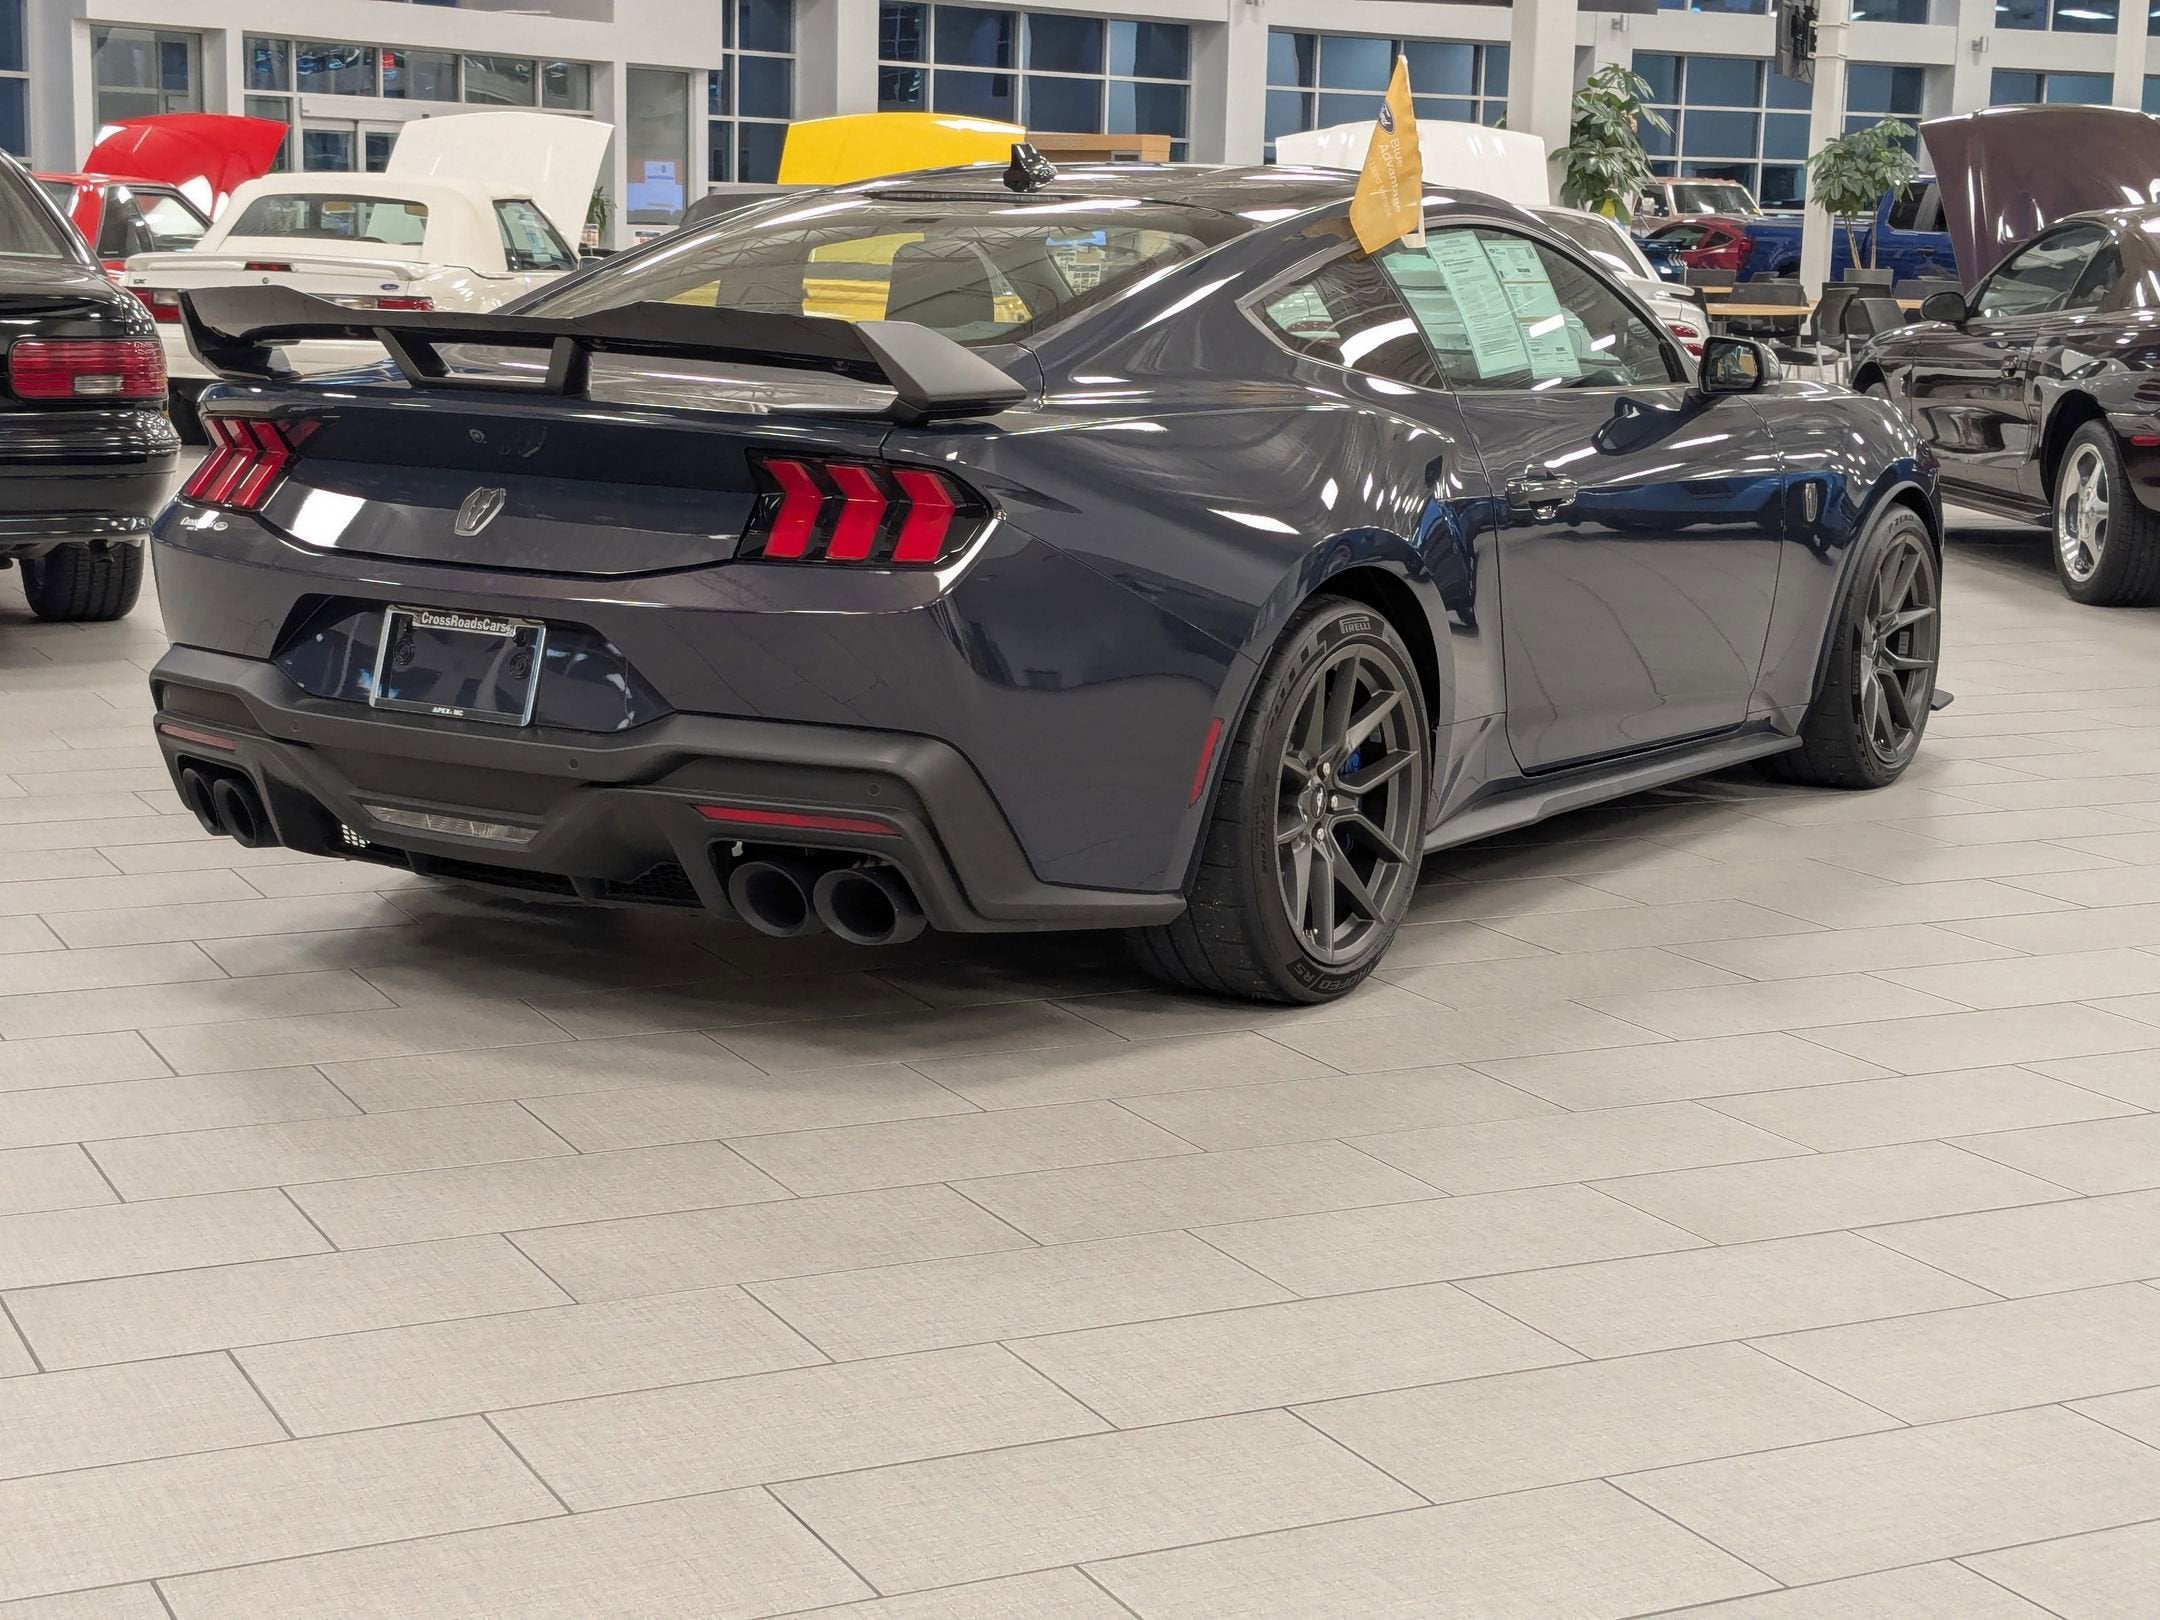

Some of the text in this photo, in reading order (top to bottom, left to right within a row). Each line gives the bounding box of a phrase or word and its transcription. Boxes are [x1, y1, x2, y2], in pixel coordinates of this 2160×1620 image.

[1391, 138, 1404, 168] Blue
[1378, 143, 1402, 213] Advantage
[1338, 616, 1372, 634] PIRELLI
